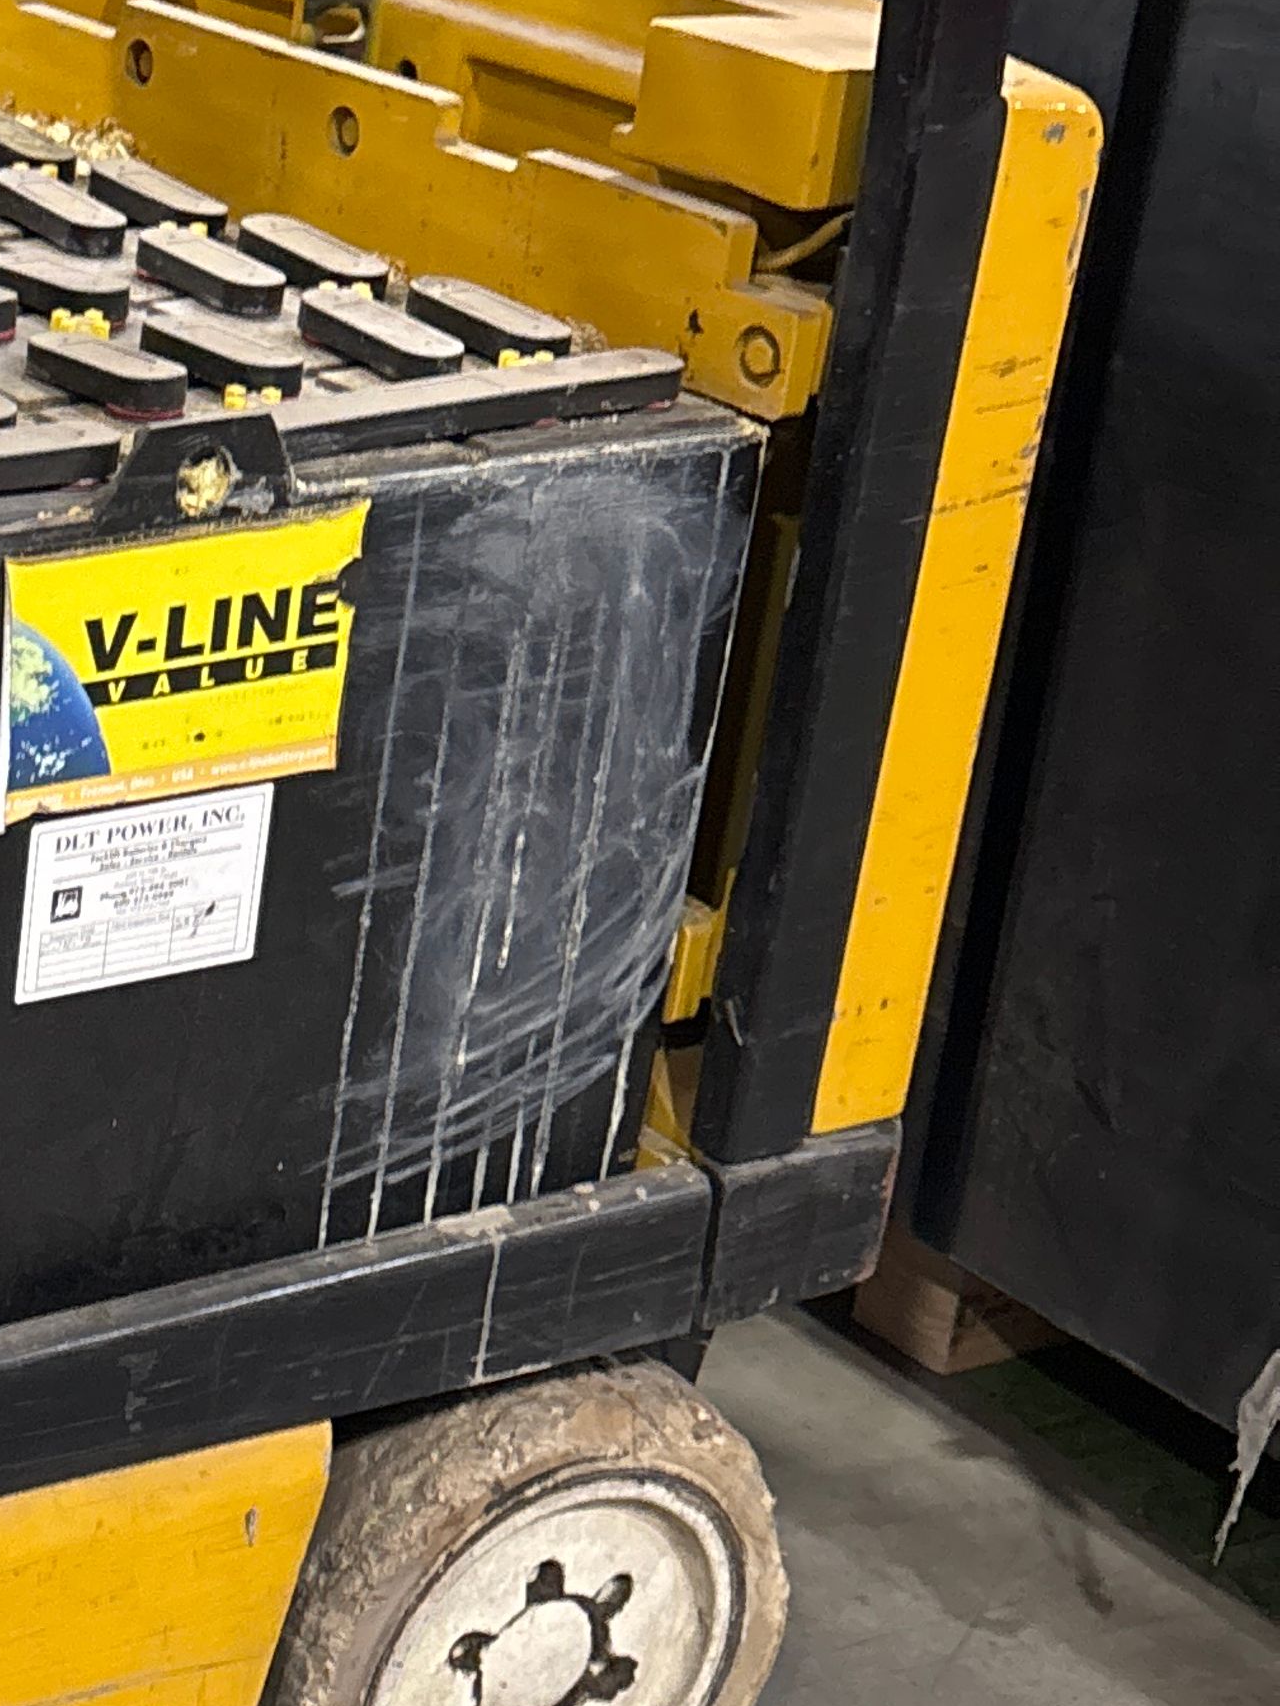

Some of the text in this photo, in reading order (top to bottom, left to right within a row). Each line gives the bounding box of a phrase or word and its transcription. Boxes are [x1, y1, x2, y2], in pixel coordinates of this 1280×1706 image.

[84, 579, 340, 675] V-LINE
[108, 649, 309, 704] VALUE
[55, 830, 100, 854] DLT
[202, 804, 246, 827] INC.
